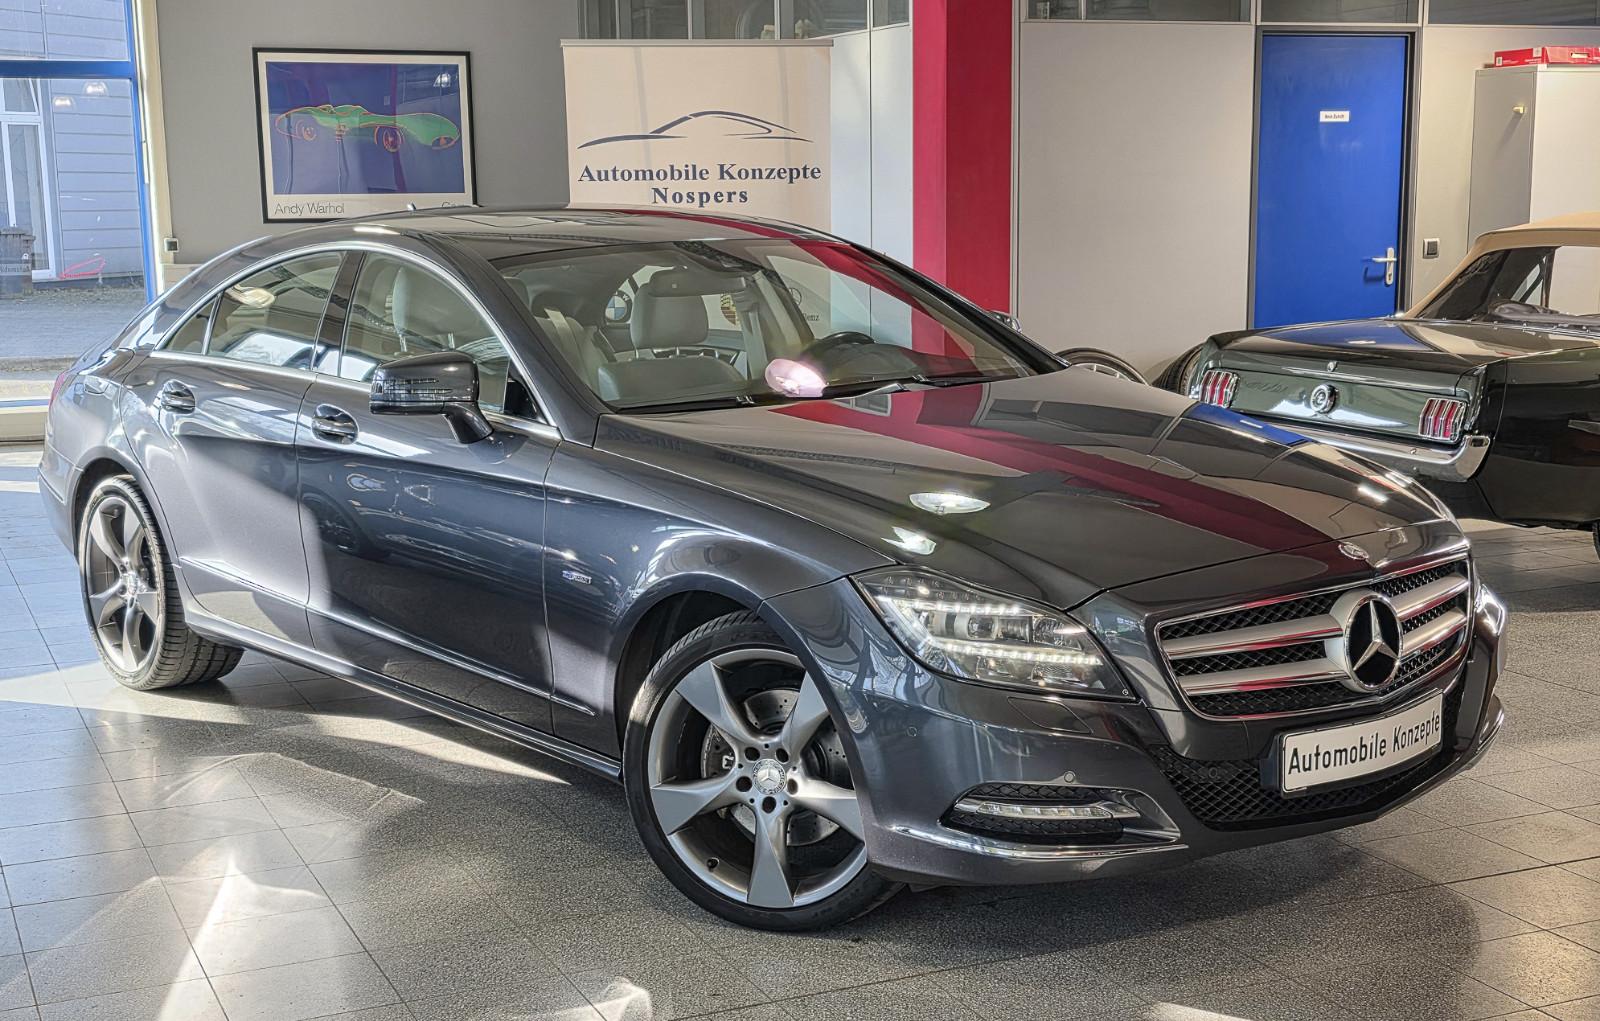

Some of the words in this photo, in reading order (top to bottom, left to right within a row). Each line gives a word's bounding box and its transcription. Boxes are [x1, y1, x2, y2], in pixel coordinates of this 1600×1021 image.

[578, 164, 710, 182] Automobile
[717, 163, 822, 184] Konzepte
[651, 187, 748, 208] Nospers
[274, 202, 305, 217] Andy
[306, 202, 345, 214] Warhol
[1288, 732, 1387, 775] Automobile
[1392, 711, 1440, 753] Konzepte
